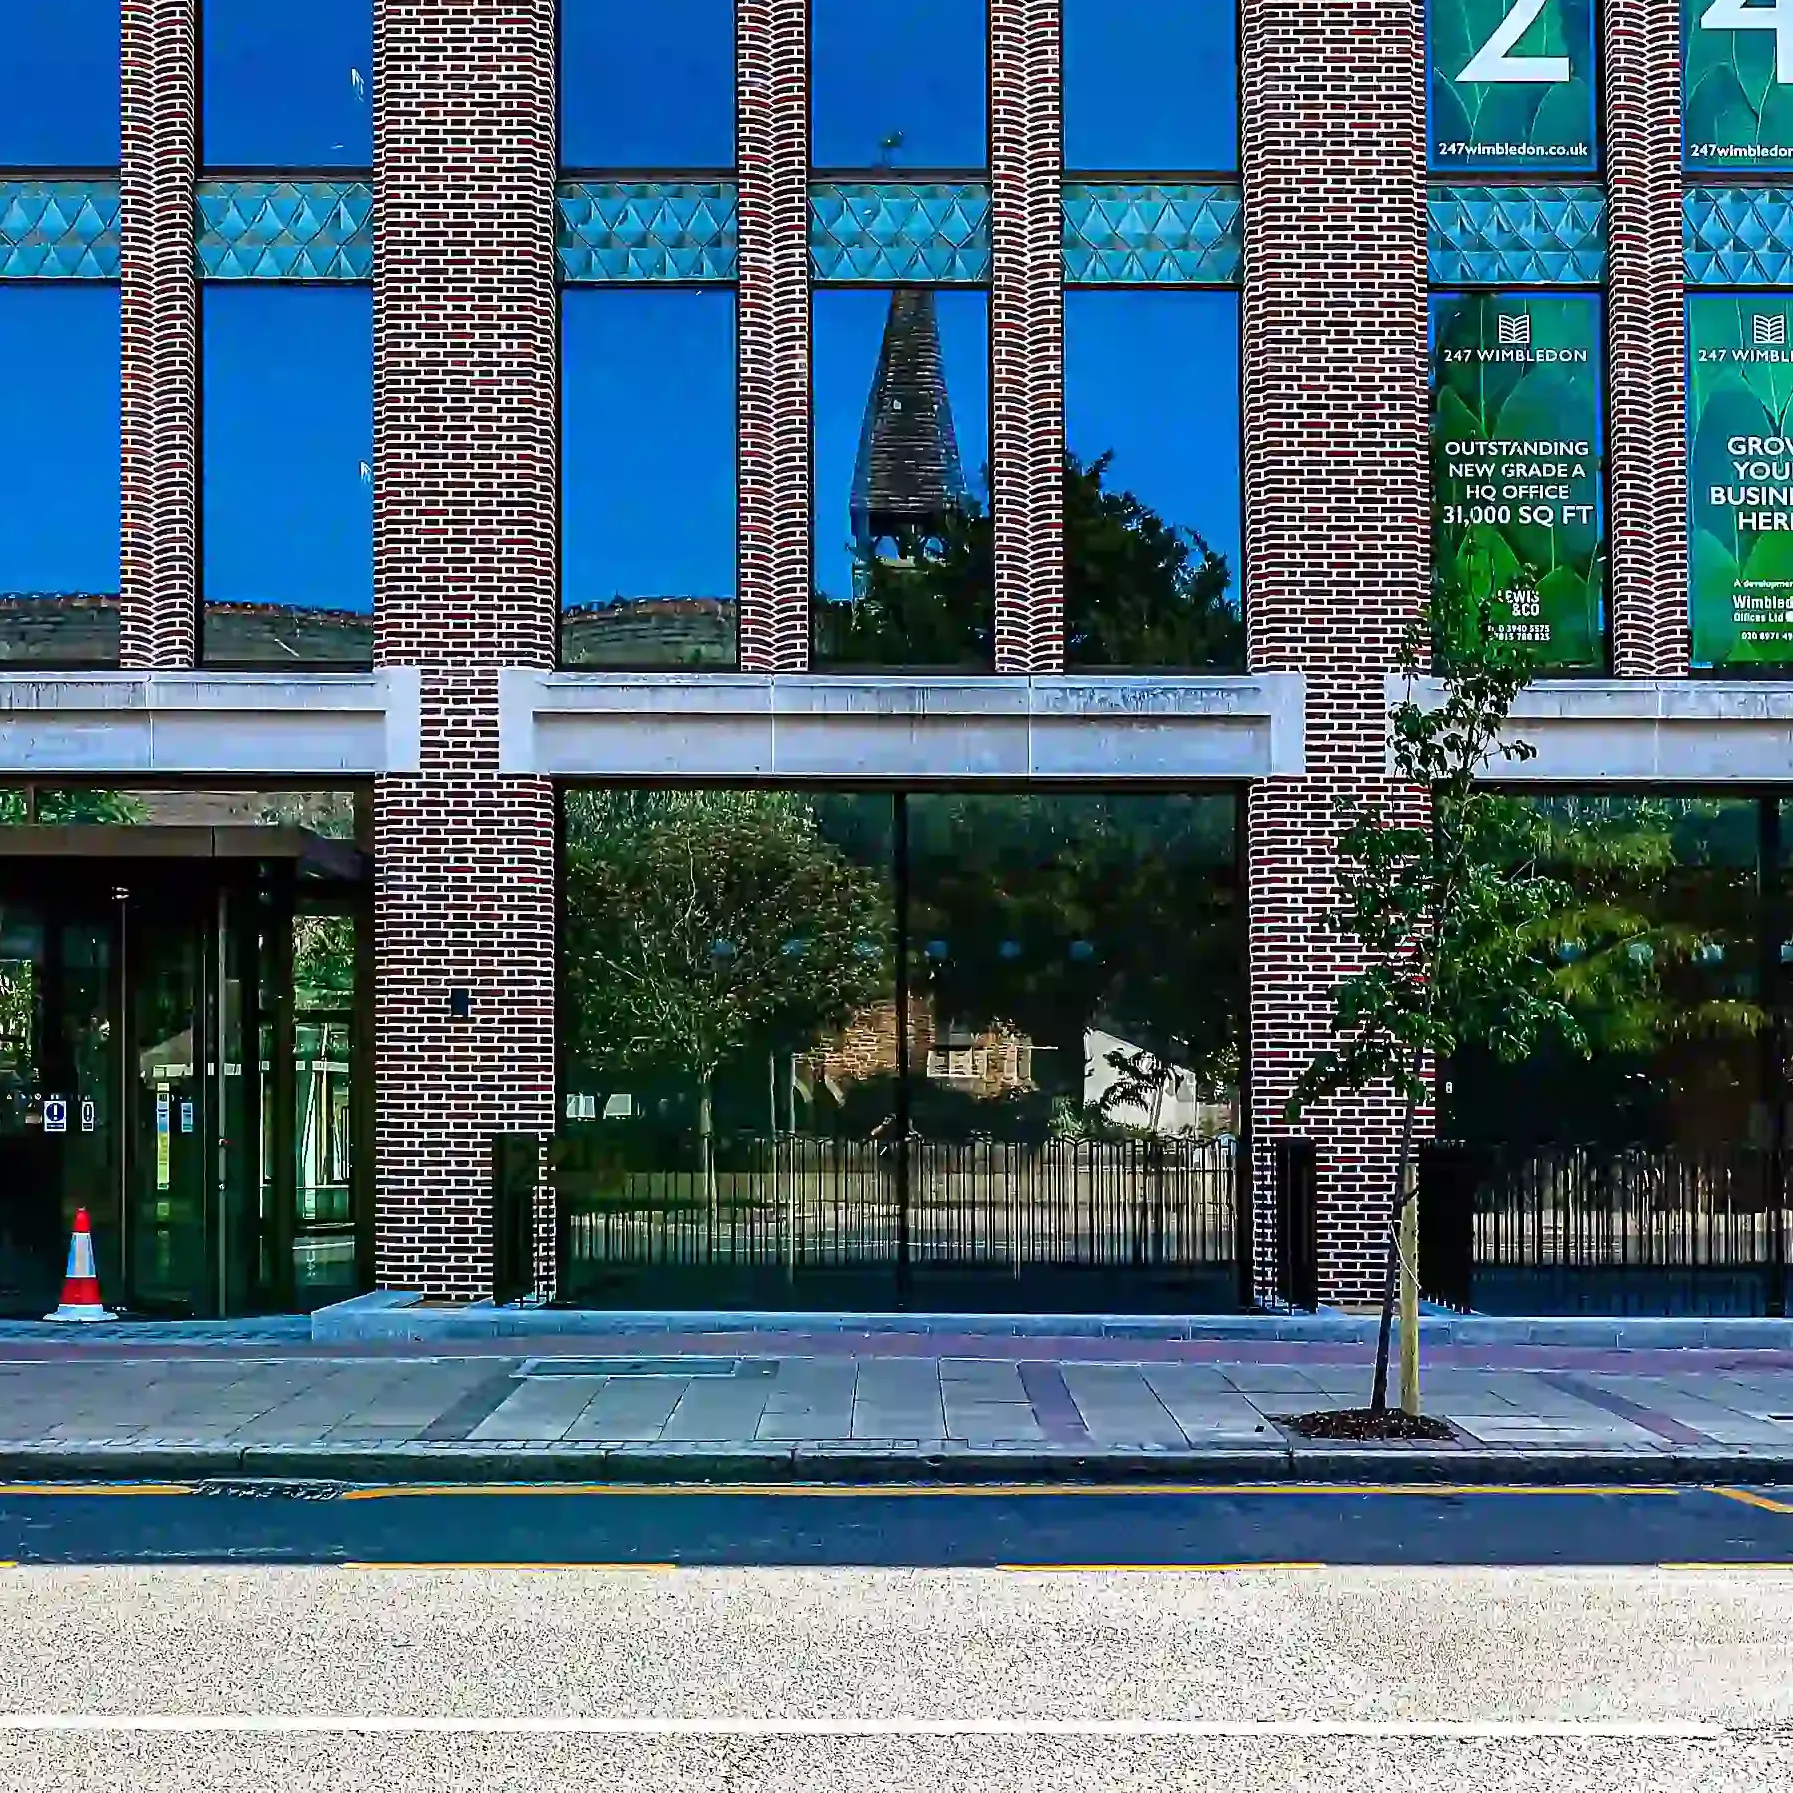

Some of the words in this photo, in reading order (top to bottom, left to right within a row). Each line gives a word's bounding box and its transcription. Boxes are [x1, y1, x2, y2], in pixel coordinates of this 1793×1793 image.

[1438, 142, 1588, 156] 247wimbledon.co.uk
[1444, 349, 1472, 362] 247
[1476, 349, 1587, 362] WIMBLEDON
[1698, 349, 1727, 362] 247
[1445, 441, 1589, 456] OUTSTANDING
[1449, 462, 1496, 478] NEW
[1501, 462, 1568, 478] GRADE
[1571, 463, 1586, 478] A
[1466, 481, 1497, 502] HQ
[1502, 484, 1569, 500] OFFICE
[1443, 505, 1511, 528] 31,000
[1518, 505, 1554, 528] SQ
[1562, 505, 1594, 525] FT
[1511, 603, 1540, 617] &CO
[1733, 612, 1766, 621] Offices
[1769, 611, 1784, 622] Ltd
